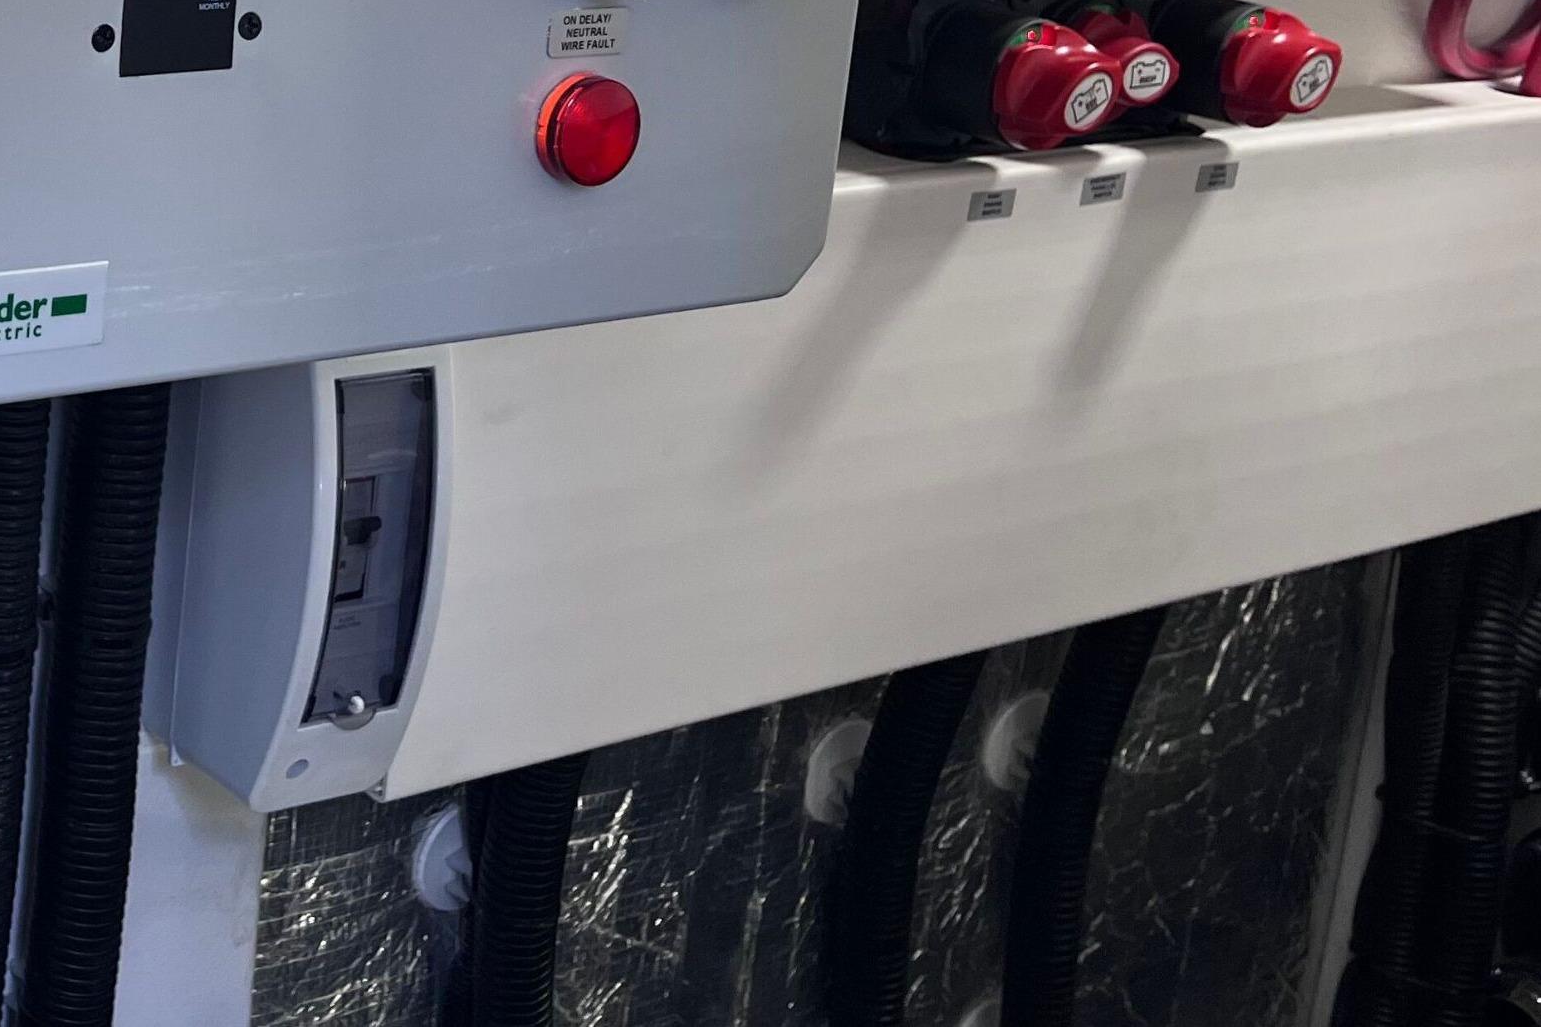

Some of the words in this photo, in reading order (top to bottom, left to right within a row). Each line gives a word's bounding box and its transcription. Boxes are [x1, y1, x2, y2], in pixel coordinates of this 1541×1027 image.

[199, 1, 231, 11] MONTHLY
[563, 15, 577, 25] ON
[565, 26, 608, 38] NEUTRAL
[561, 40, 584, 51] WIRE
[586, 38, 616, 50] FAULT
